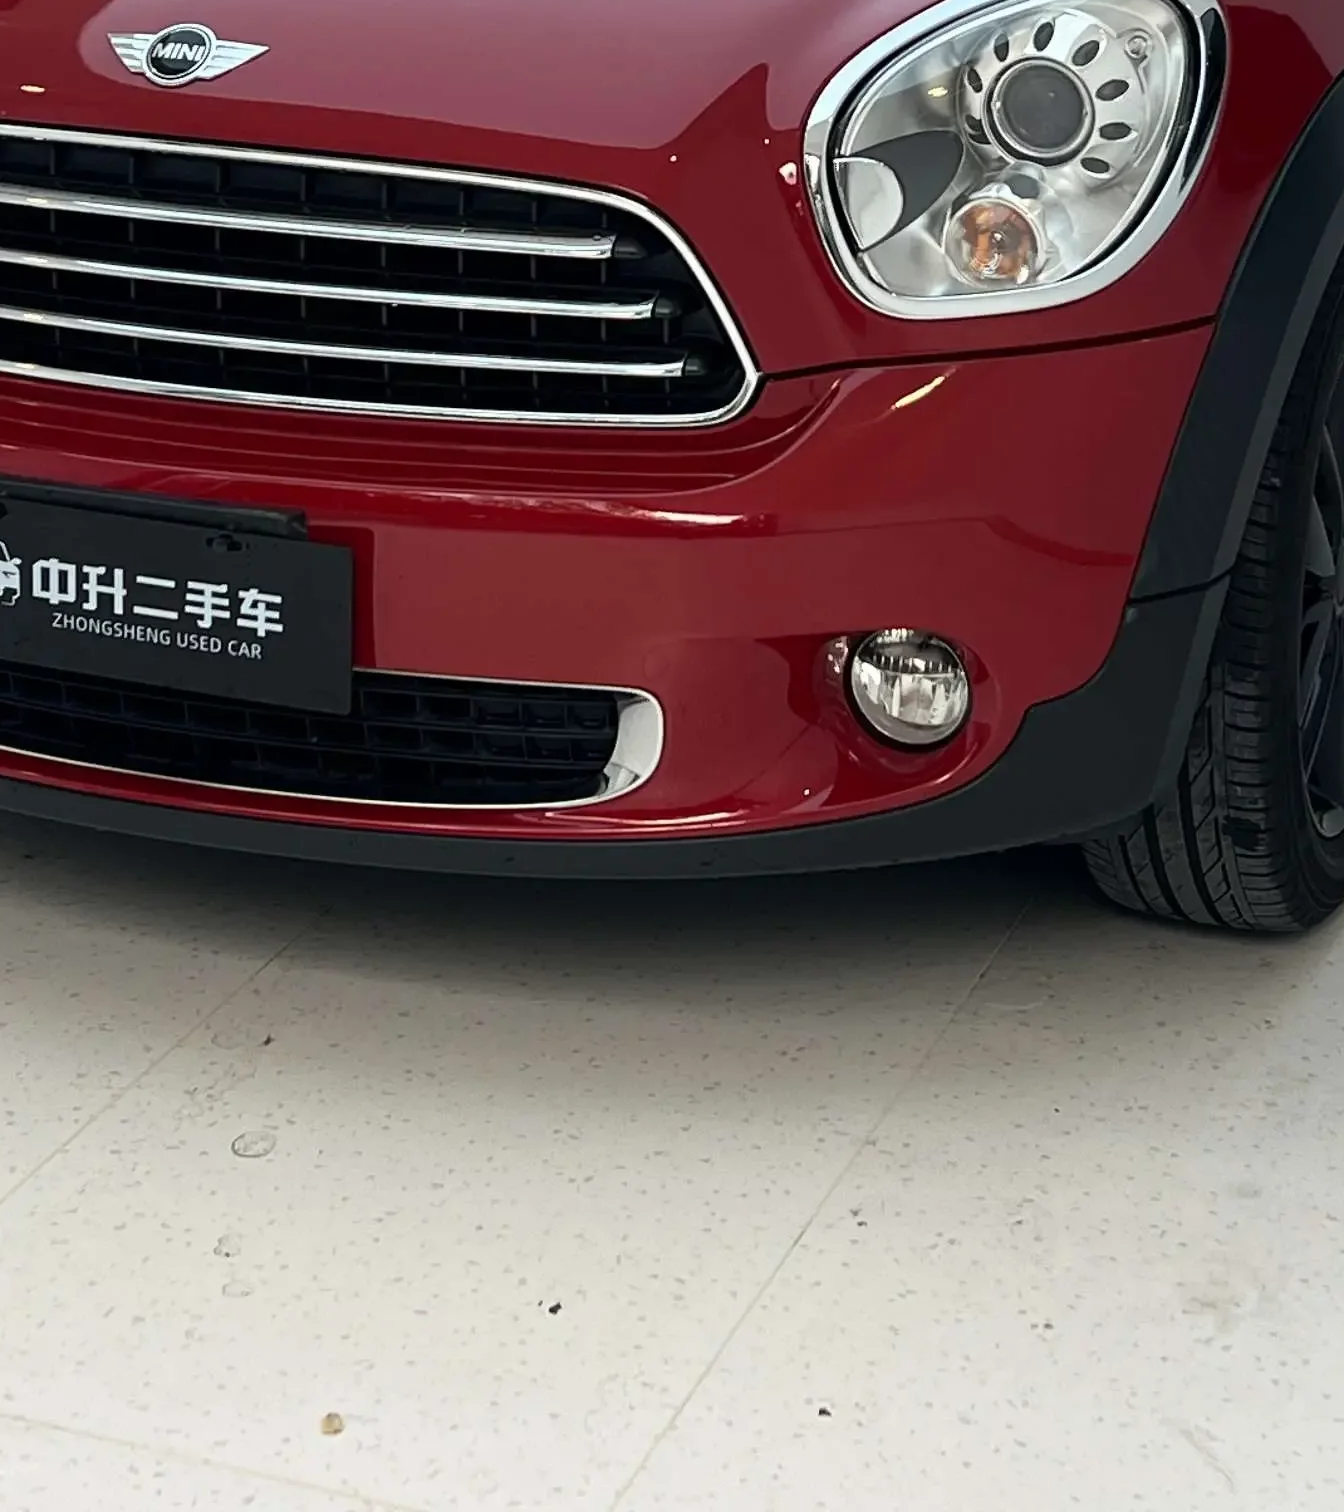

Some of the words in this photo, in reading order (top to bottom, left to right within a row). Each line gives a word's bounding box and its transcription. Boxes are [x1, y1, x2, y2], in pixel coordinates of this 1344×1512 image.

[152, 42, 207, 62] MINI
[32, 558, 284, 637] 中升二手车
[52, 612, 171, 646] ZHONGSHENG
[176, 632, 222, 653] USED
[227, 640, 262, 659] CAR
